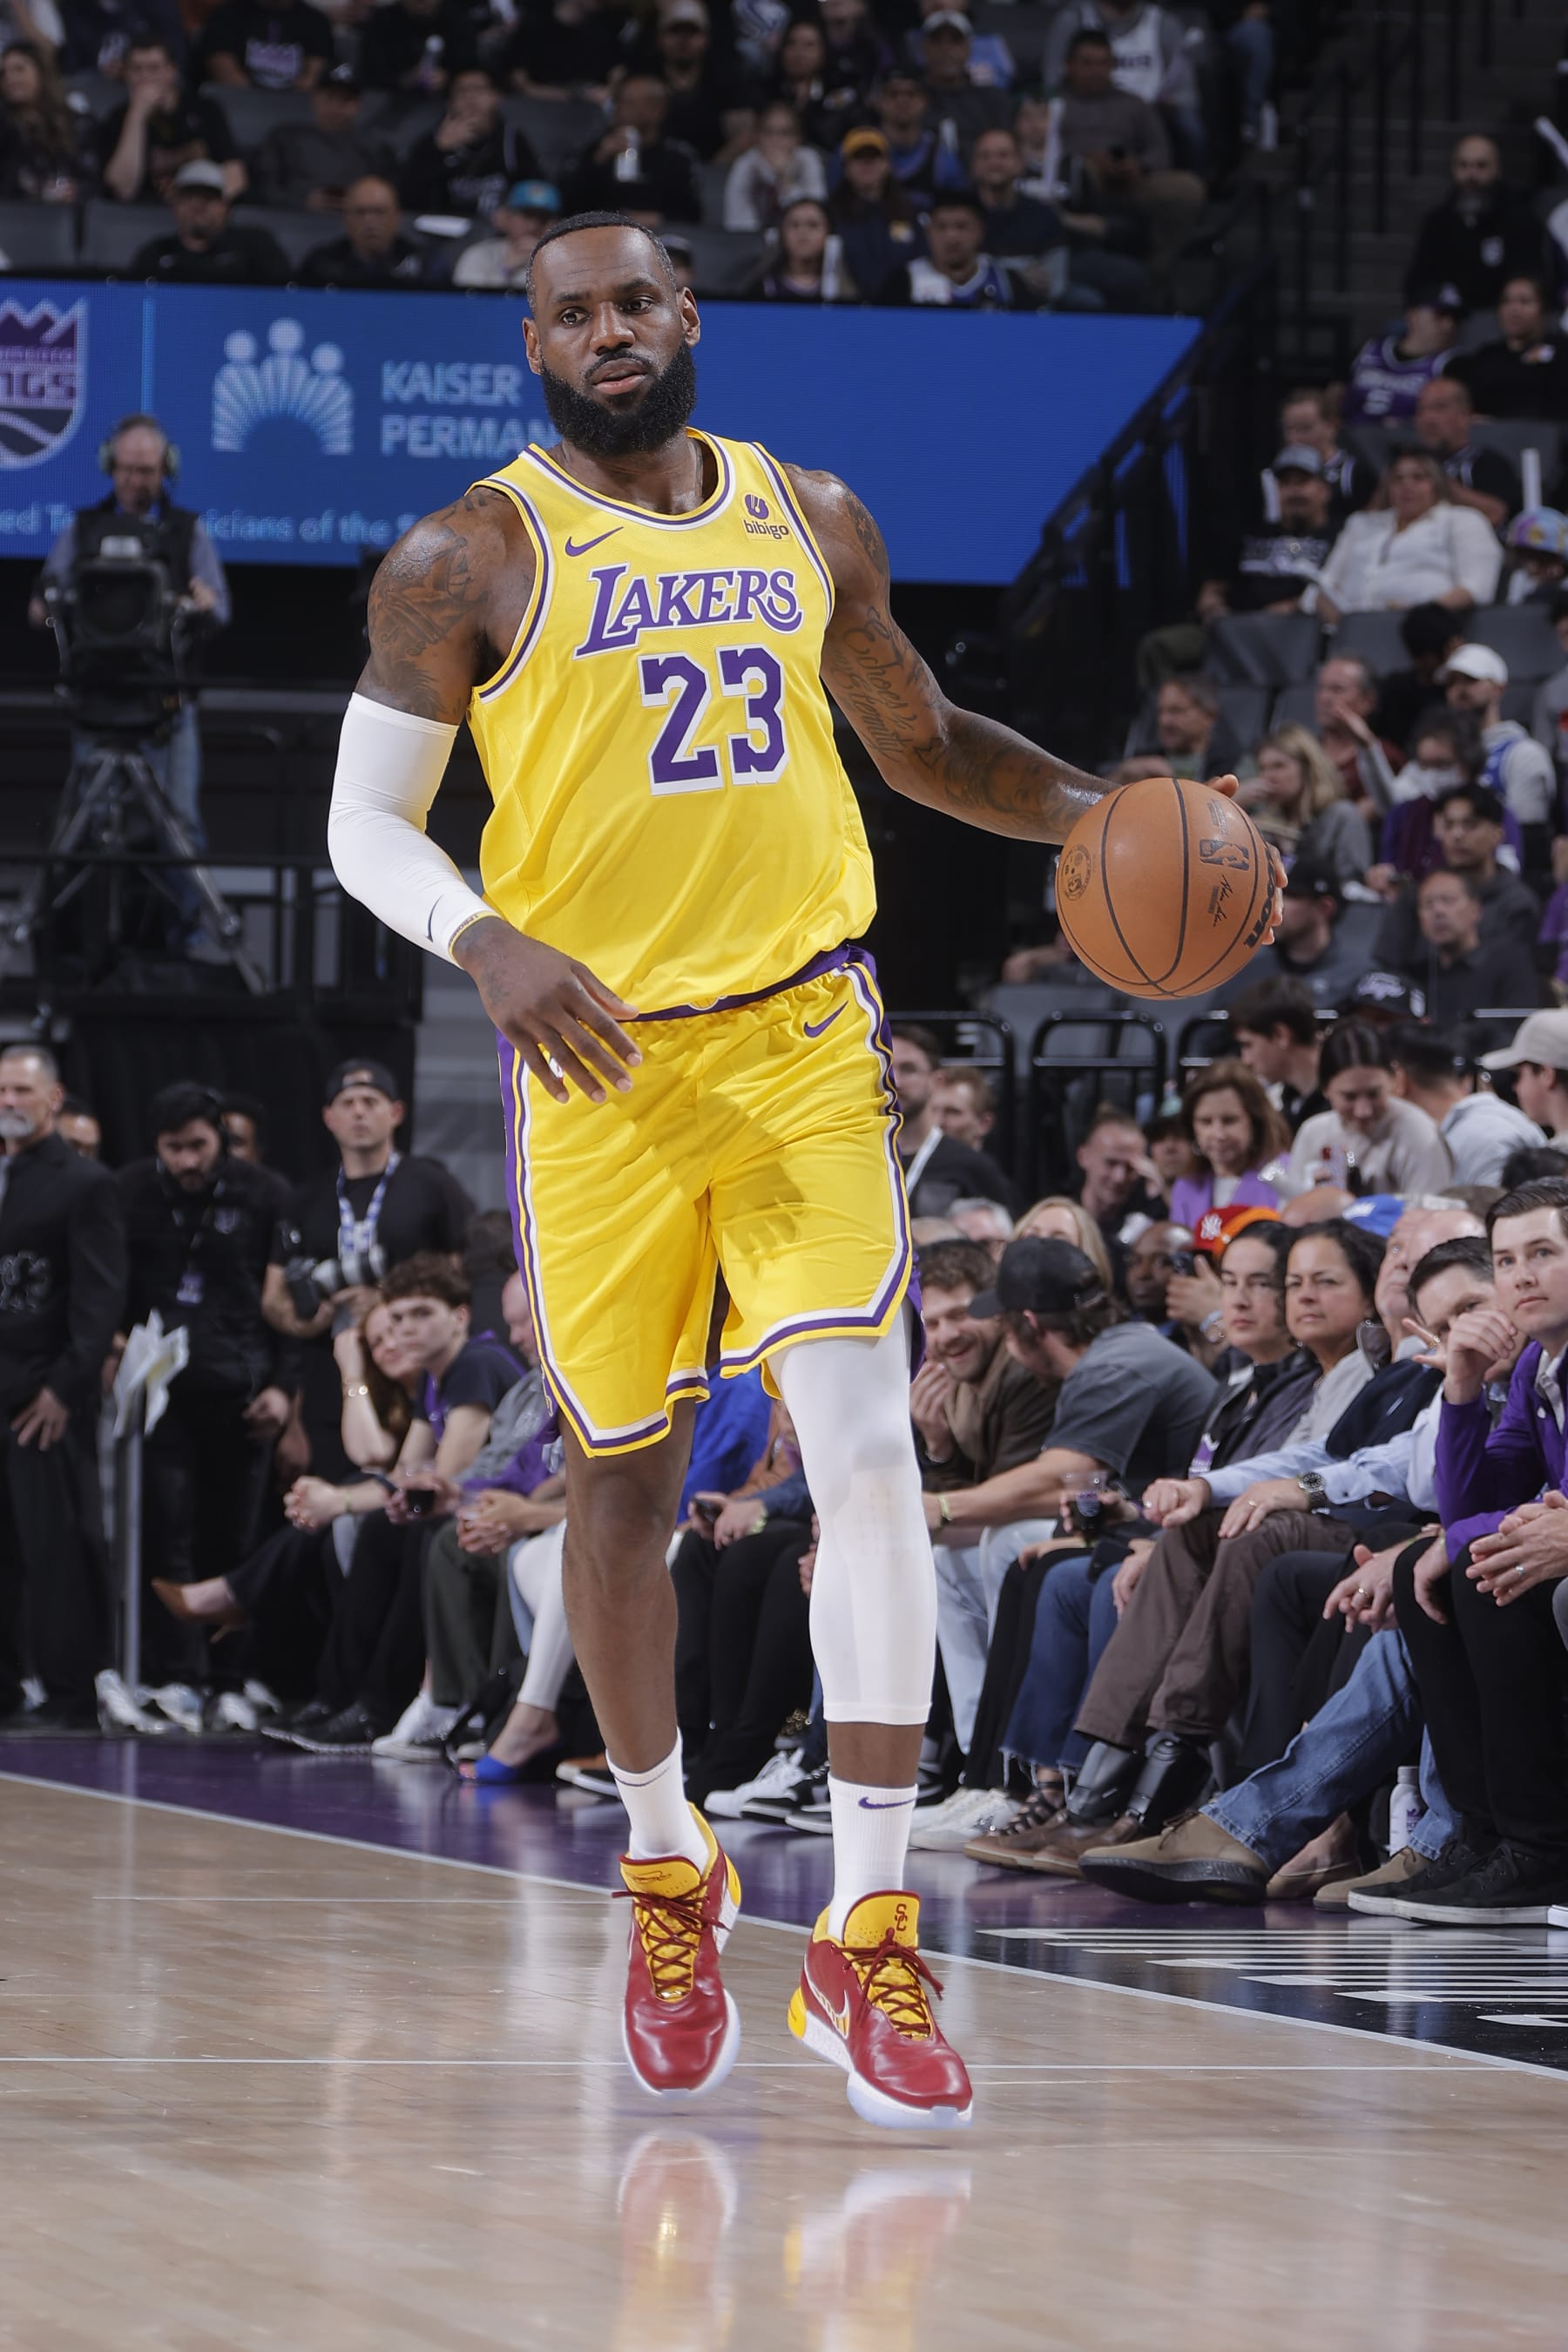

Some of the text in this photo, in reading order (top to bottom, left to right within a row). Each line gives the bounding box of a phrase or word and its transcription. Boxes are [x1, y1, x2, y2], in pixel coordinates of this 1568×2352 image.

[382, 361, 522, 407] KAISER
[300, 509, 336, 543] of
[340, 510, 391, 544] the
[742, 518, 790, 539] bibigo
[571, 561, 804, 660] LAKERS
[637, 643, 789, 796] 23
